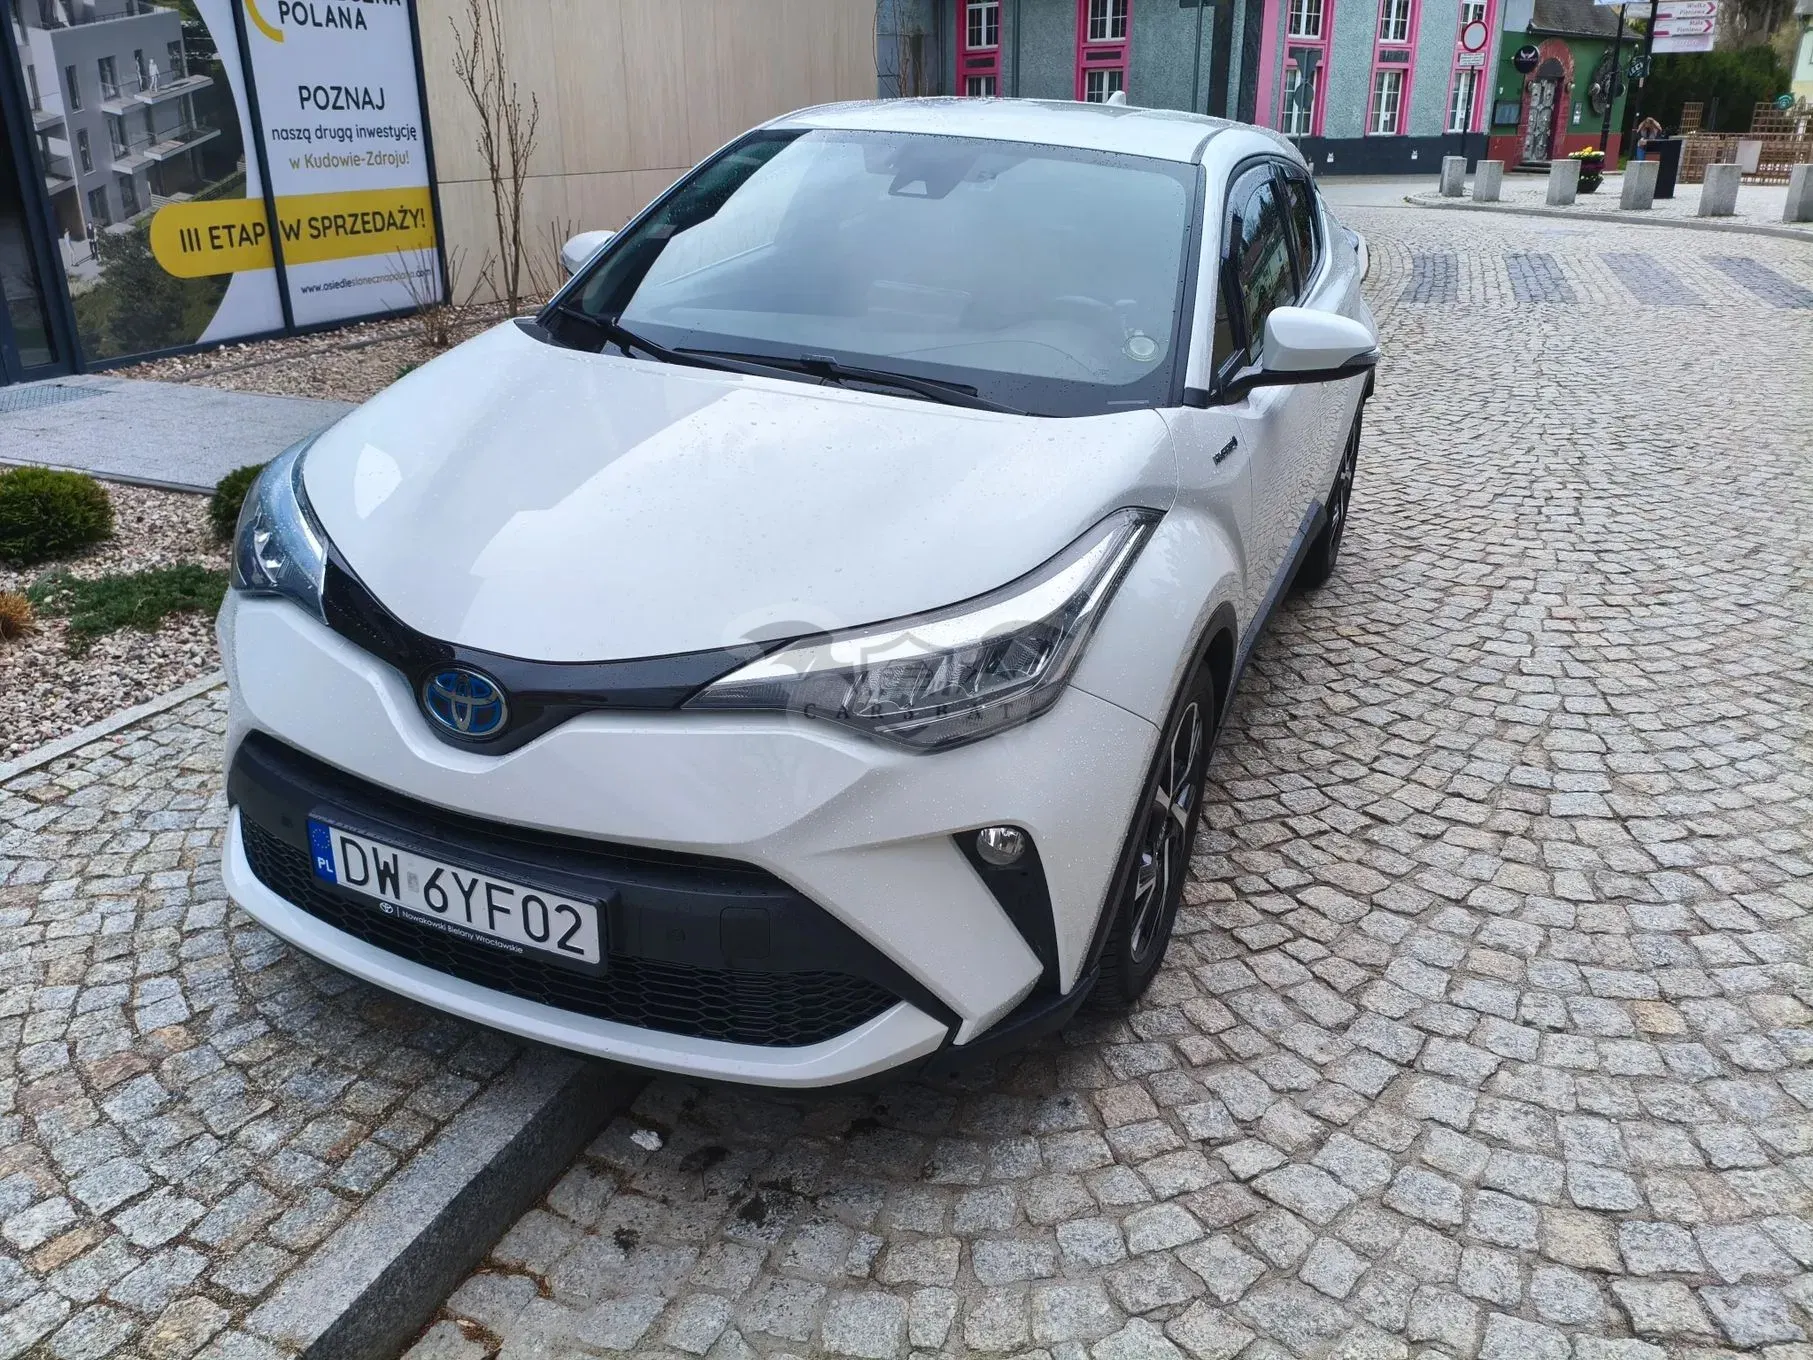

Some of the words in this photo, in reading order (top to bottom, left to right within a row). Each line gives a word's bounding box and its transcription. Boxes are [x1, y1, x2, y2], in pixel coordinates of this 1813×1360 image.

[278, 0, 368, 30] POLANA
[298, 85, 385, 110] POZNAJ
[271, 127, 312, 144] naszą
[314, 124, 353, 143] drugą
[355, 123, 417, 142] inwestycję
[289, 157, 301, 170] w
[304, 150, 410, 169] Kudowie-Zdroju!
[179, 227, 202, 253] III
[208, 222, 266, 251] ETAP
[280, 218, 301, 242] W
[308, 204, 426, 240] SPRZEDAŻY!
[317, 856, 334, 873] PL
[340, 835, 401, 900] DW
[423, 867, 585, 956] 6YF02
[402, 910, 447, 931] Nowakowski
[447, 924, 475, 940] Bielany
[475, 933, 524, 954] Wrocławskie
